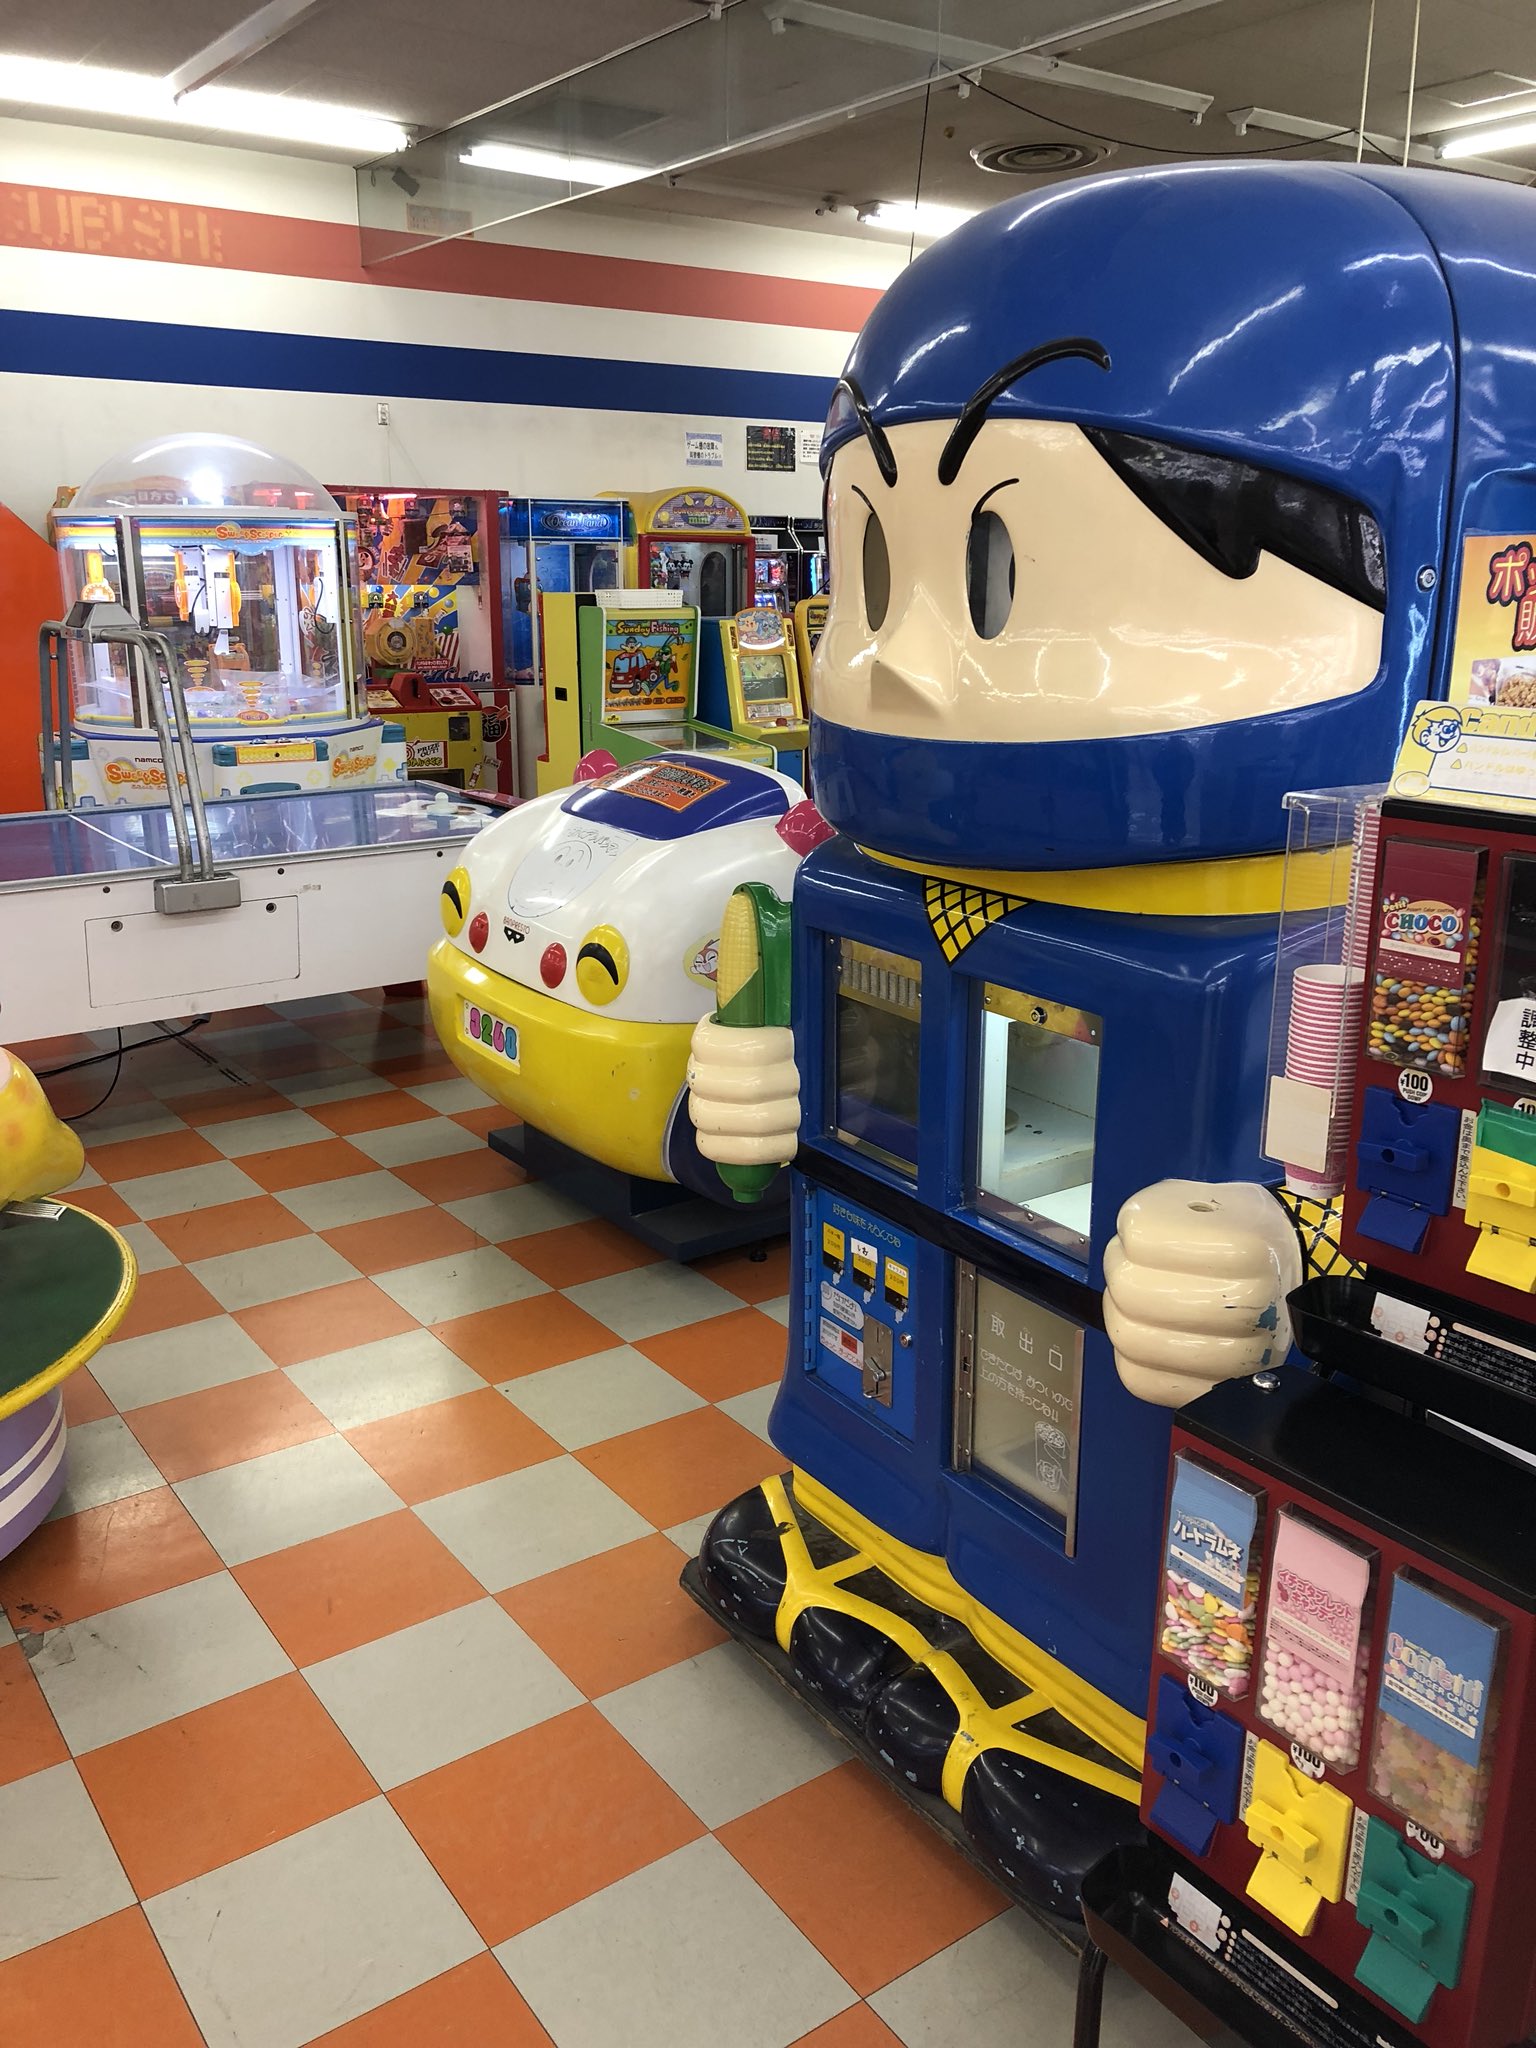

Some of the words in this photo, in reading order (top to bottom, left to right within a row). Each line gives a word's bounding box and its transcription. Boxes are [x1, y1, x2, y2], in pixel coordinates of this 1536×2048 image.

[552, 515, 578, 527] Ocean
[583, 517, 604, 529] Land
[617, 621, 651, 636] Sunday
[651, 621, 679, 635] Fishing
[417, 743, 440, 754] PRIZE
[503, 916, 531, 935] BANPRESTO
[1386, 912, 1458, 933] CHOCO
[470, 1007, 518, 1060] 3268
[1400, 1072, 1428, 1092] ¥100
[1173, 1520, 1243, 1561] ハートラムネ
[1279, 1570, 1354, 1621] イチゴタブレット
[1291, 1591, 1336, 1628] キャンディ
[1412, 1671, 1445, 1695] SUGER
[1446, 1692, 1479, 1715] CANDY
